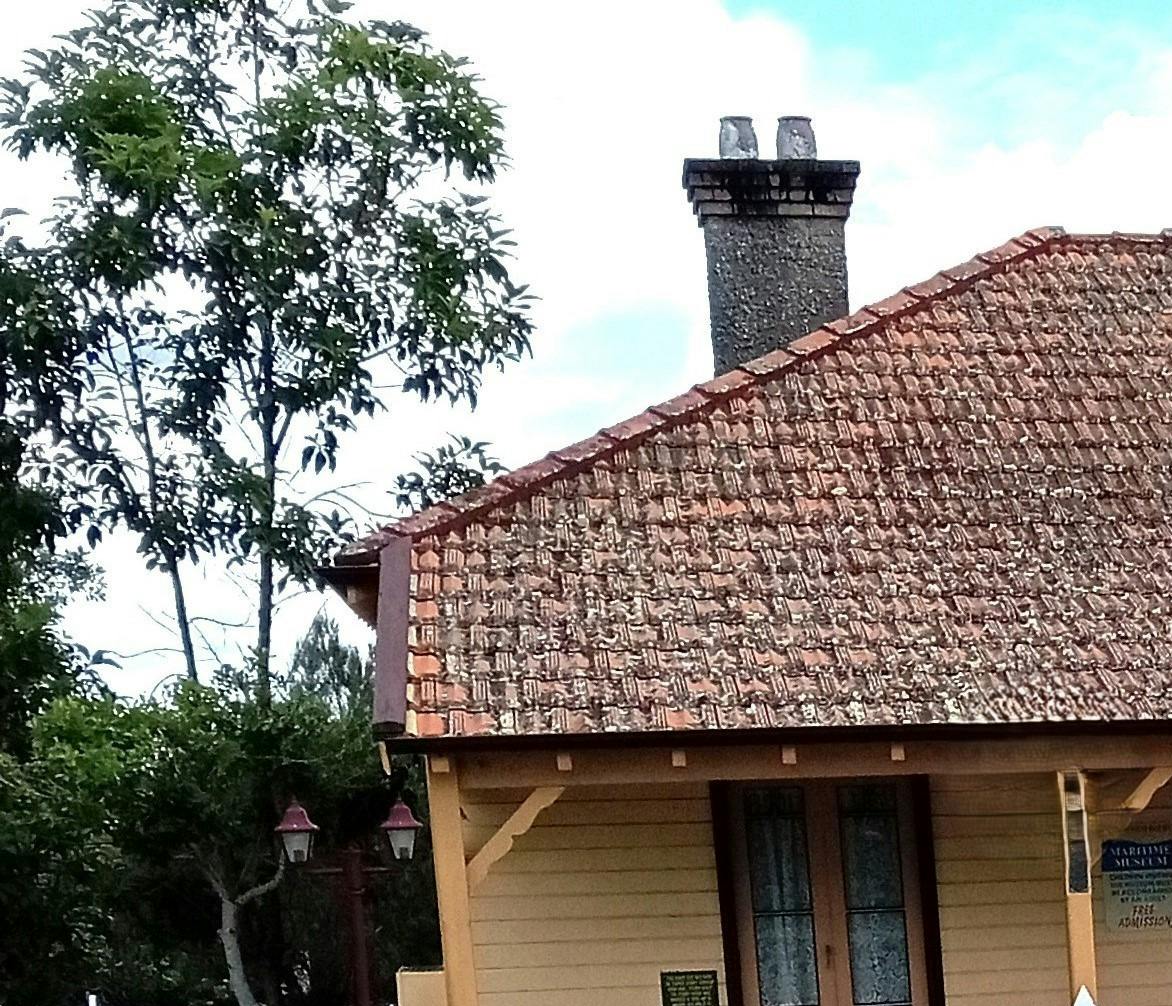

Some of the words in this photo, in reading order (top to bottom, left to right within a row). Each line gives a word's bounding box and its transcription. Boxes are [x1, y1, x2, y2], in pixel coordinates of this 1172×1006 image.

[1110, 845, 1170, 857] MARITIME
[1115, 856, 1168, 868] MUSEUM
[1132, 904, 1154, 916] FREE
